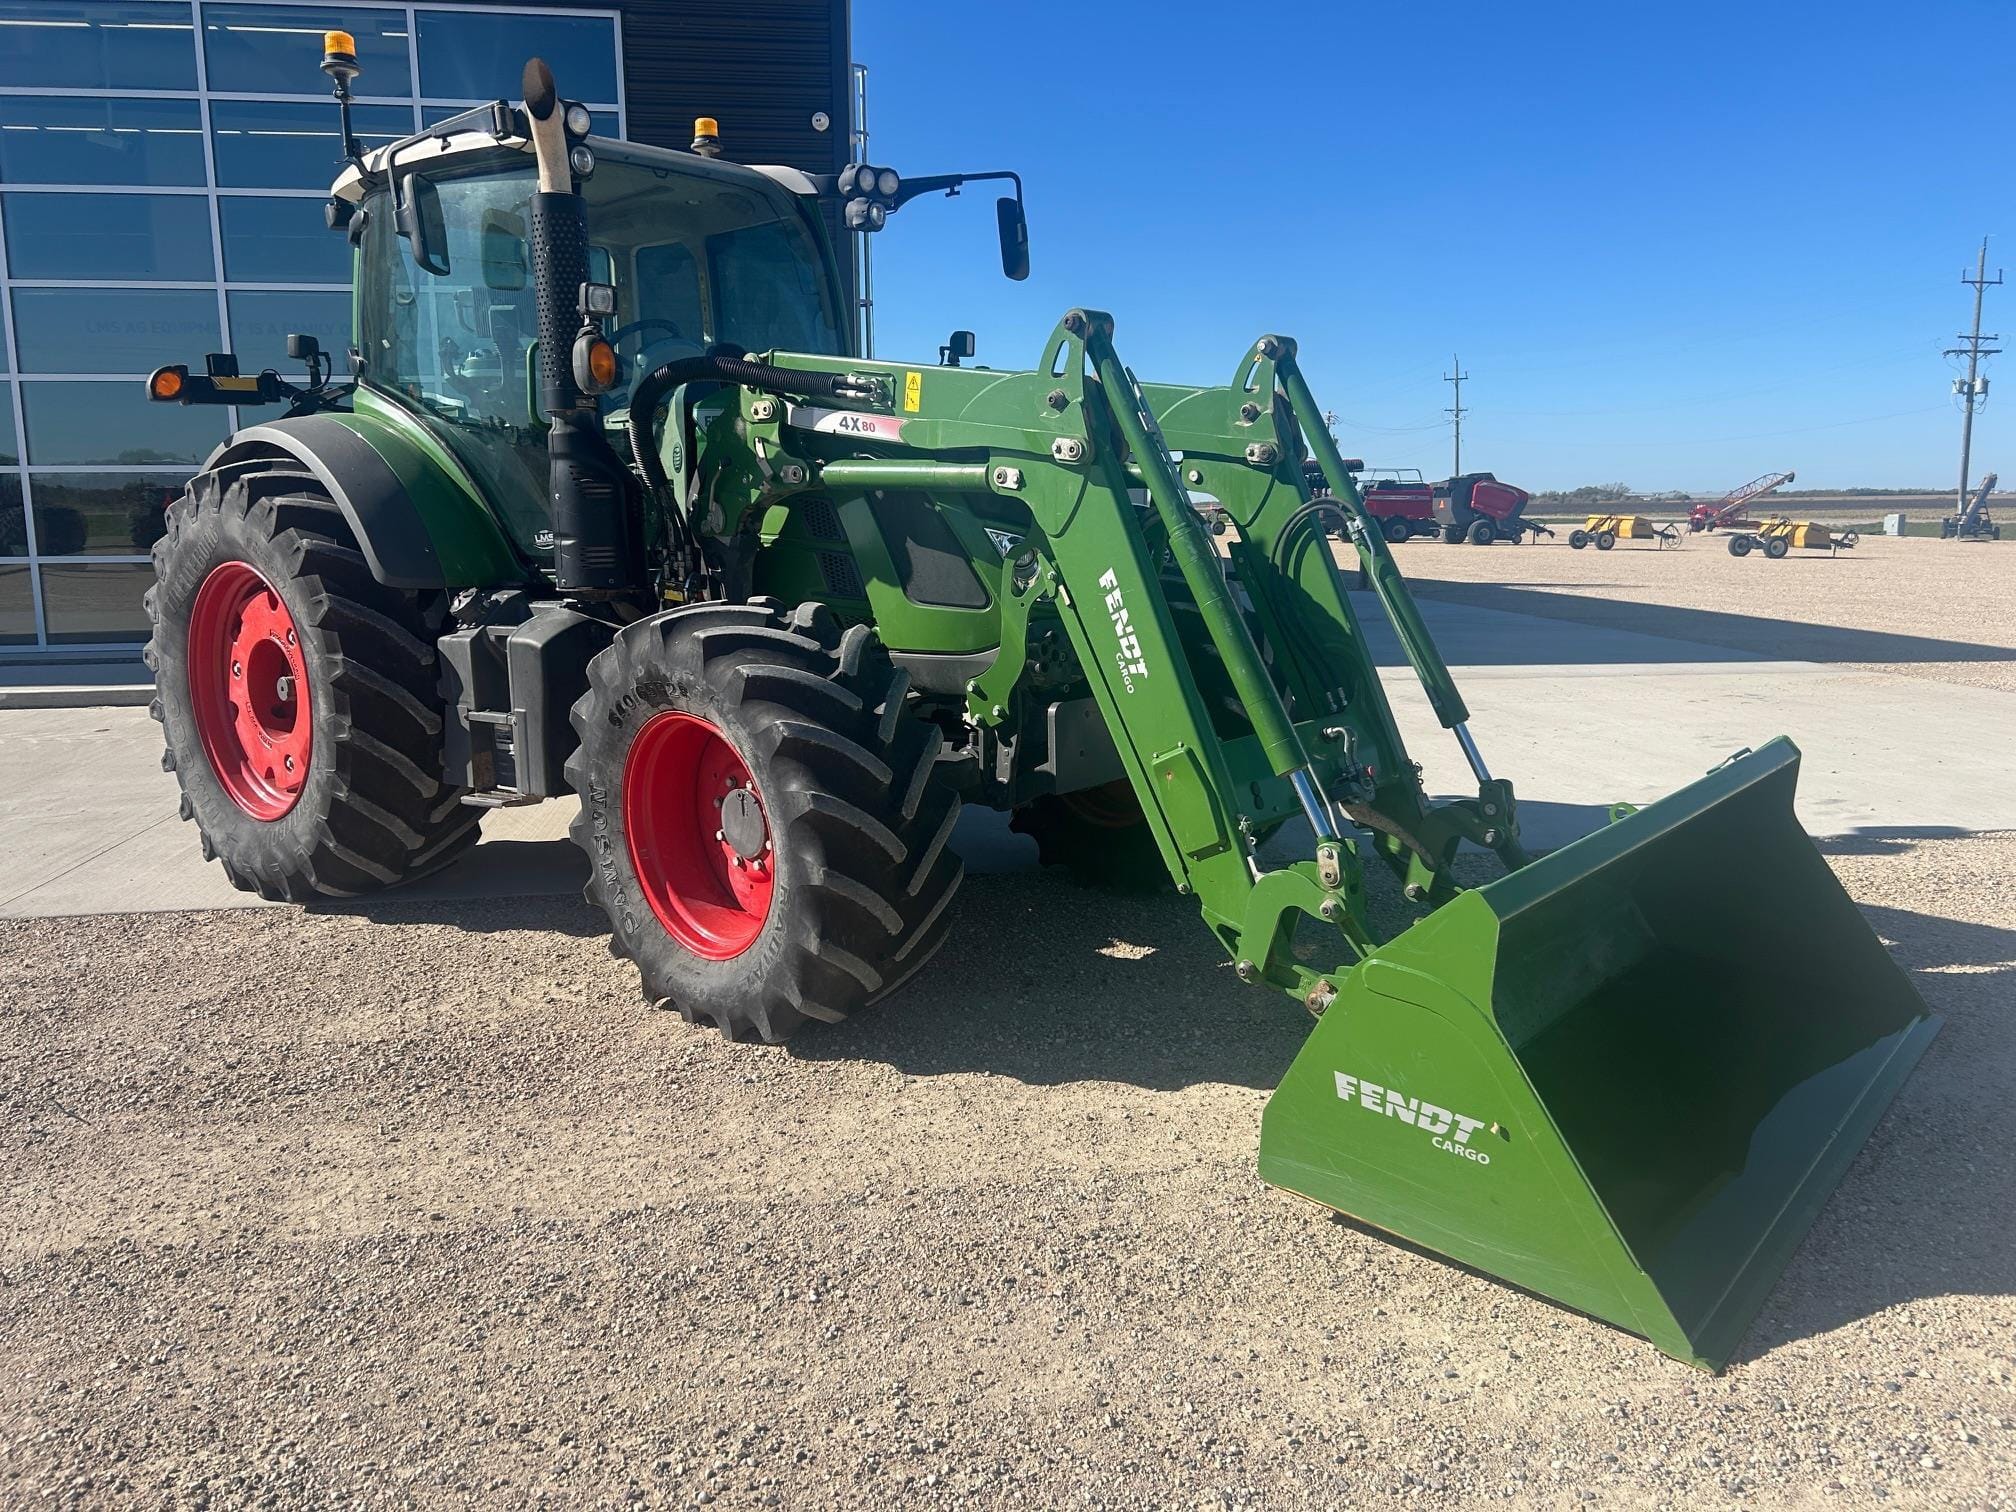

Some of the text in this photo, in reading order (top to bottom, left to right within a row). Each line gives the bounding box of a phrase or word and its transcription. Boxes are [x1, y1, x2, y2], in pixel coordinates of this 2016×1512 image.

[533, 533, 555, 543] LMS
[1098, 566, 1149, 679] FENDT
[1115, 652, 1135, 695] CARGO
[587, 783, 641, 936] SAMSON
[1333, 1070, 1486, 1144] FENDT
[1431, 1136, 1491, 1165] CARGO
